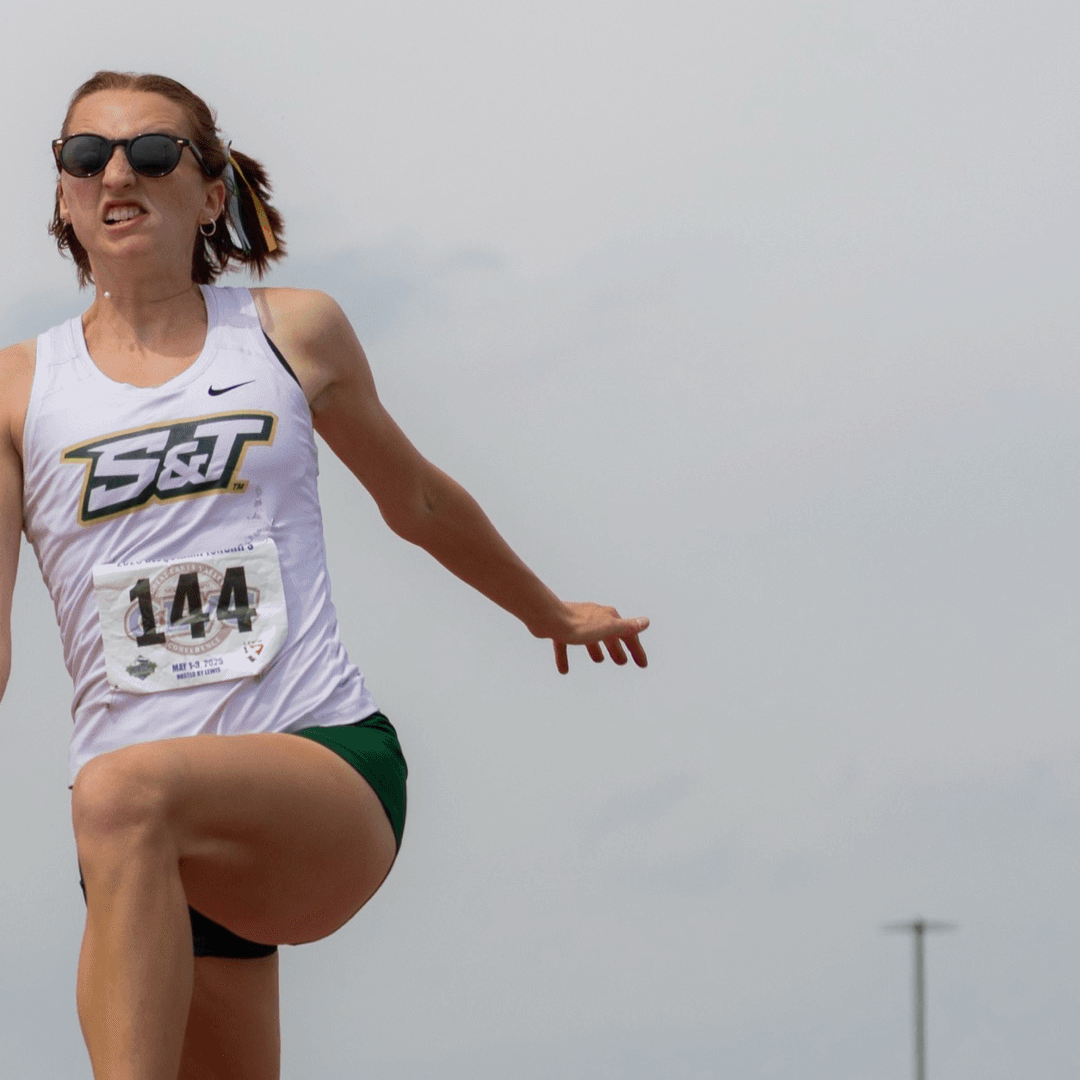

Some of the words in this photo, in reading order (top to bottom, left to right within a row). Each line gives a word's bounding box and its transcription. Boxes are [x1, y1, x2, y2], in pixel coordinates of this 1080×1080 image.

[69, 413, 274, 521] S&T
[129, 566, 257, 647] 144
[172, 662, 186, 672] MAY
[204, 657, 224, 667] 2025
